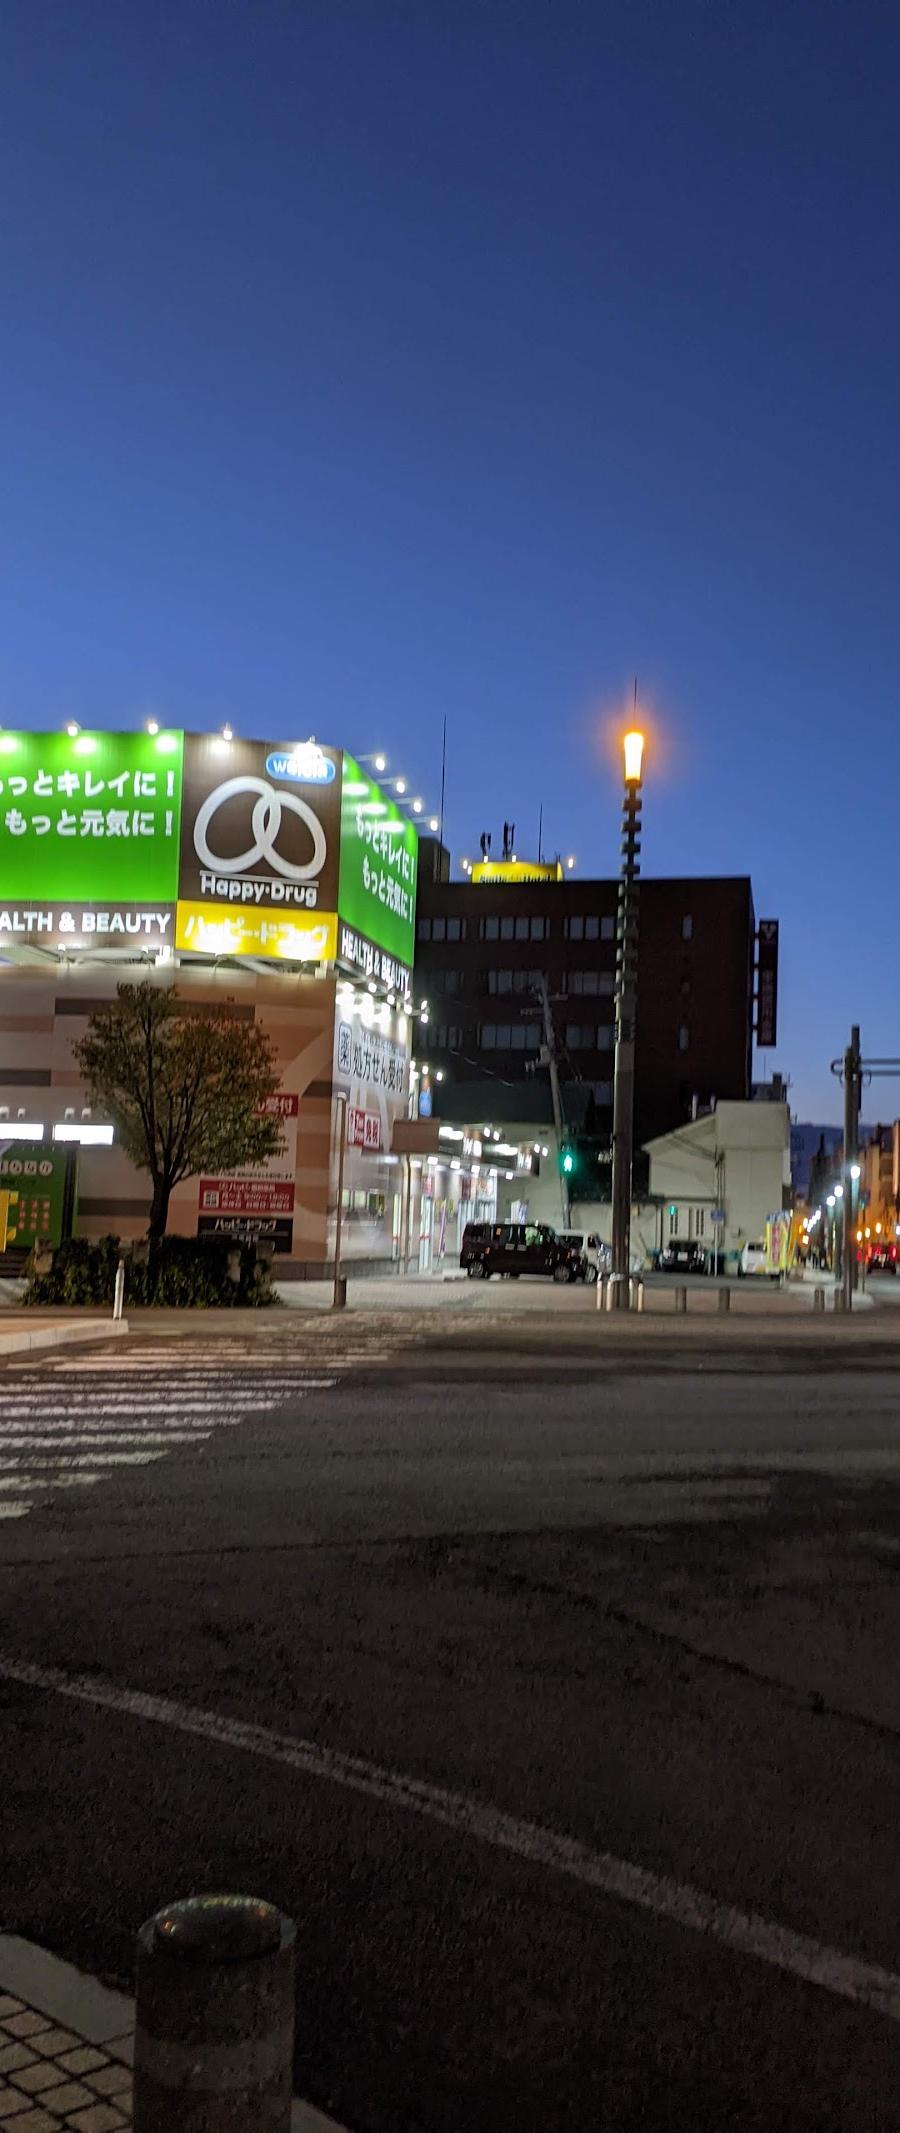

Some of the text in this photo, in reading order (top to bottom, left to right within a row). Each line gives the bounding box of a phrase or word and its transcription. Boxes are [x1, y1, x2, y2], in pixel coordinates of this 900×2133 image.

[5, 808, 173, 837] もっと元気に！
[58, 911, 76, 933] &
[82, 911, 171, 934] BEAUTY
[341, 928, 412, 995] HEALTH & BEAUTY
[340, 1029, 351, 1067] 薬
[352, 1041, 404, 1093] 処方せん受付
